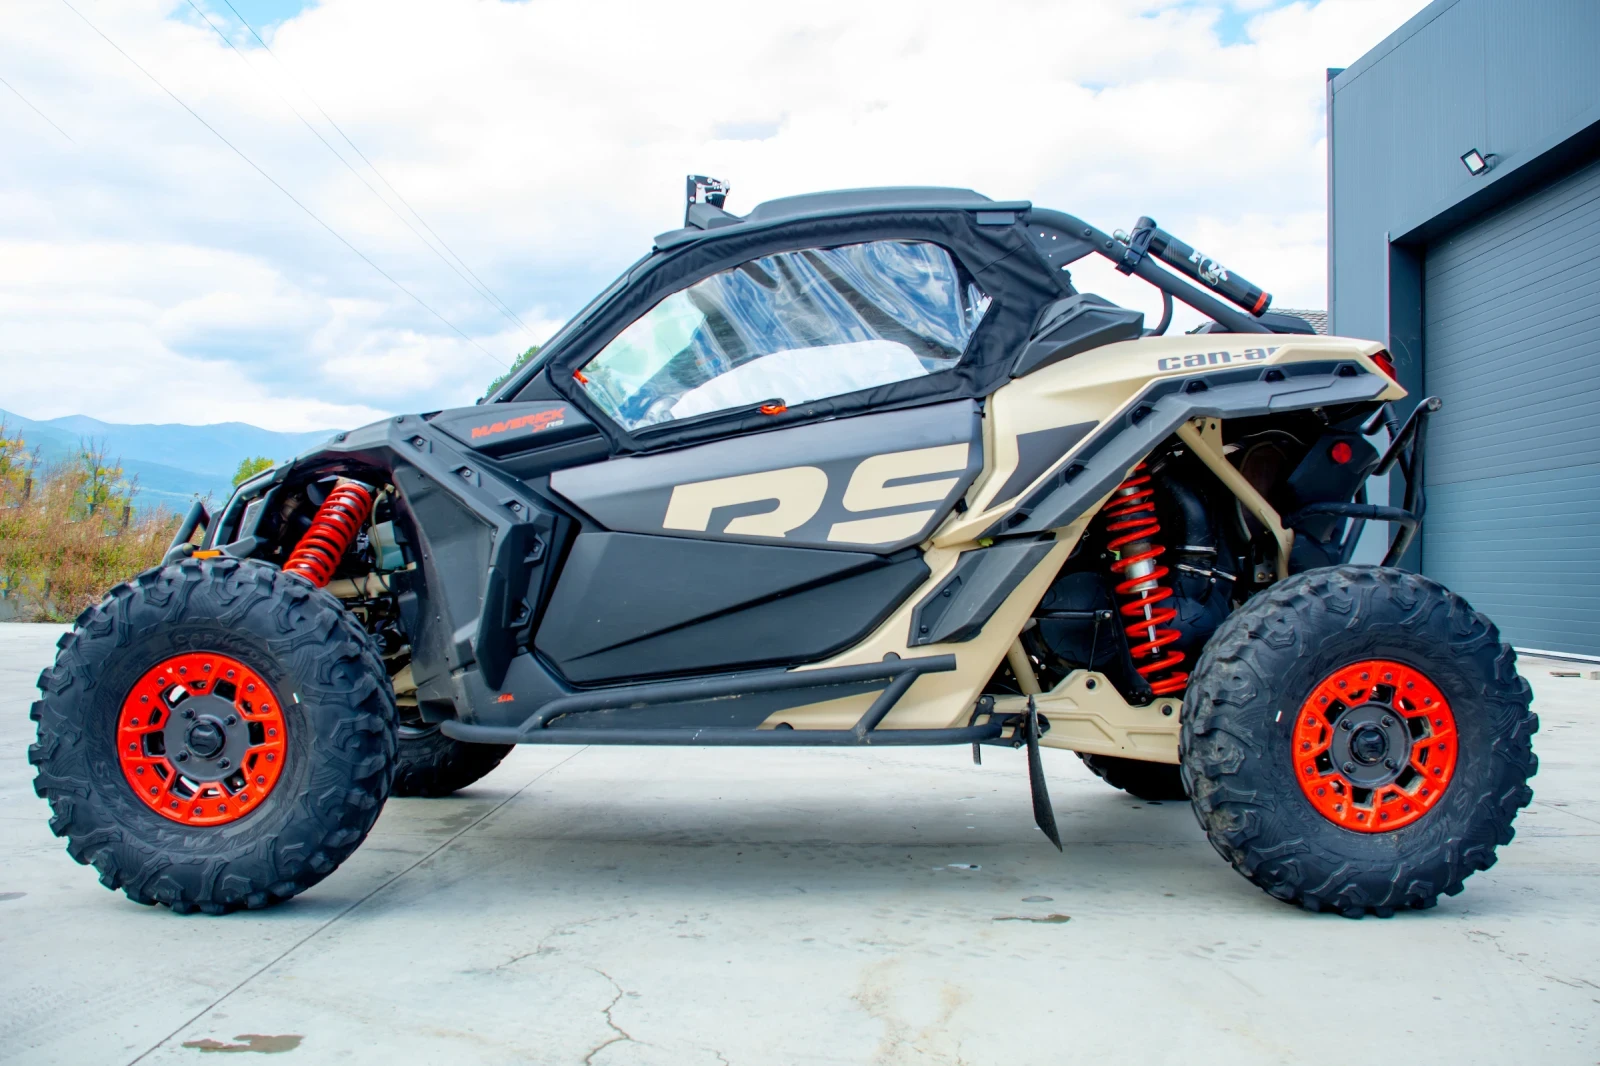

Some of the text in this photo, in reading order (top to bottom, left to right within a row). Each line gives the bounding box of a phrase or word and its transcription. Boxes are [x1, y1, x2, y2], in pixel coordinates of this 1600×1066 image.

[1187, 249, 1229, 285] FOX
[1157, 346, 1281, 372] can-a
[471, 407, 566, 439] MAVERICK
[662, 442, 970, 544] RS
